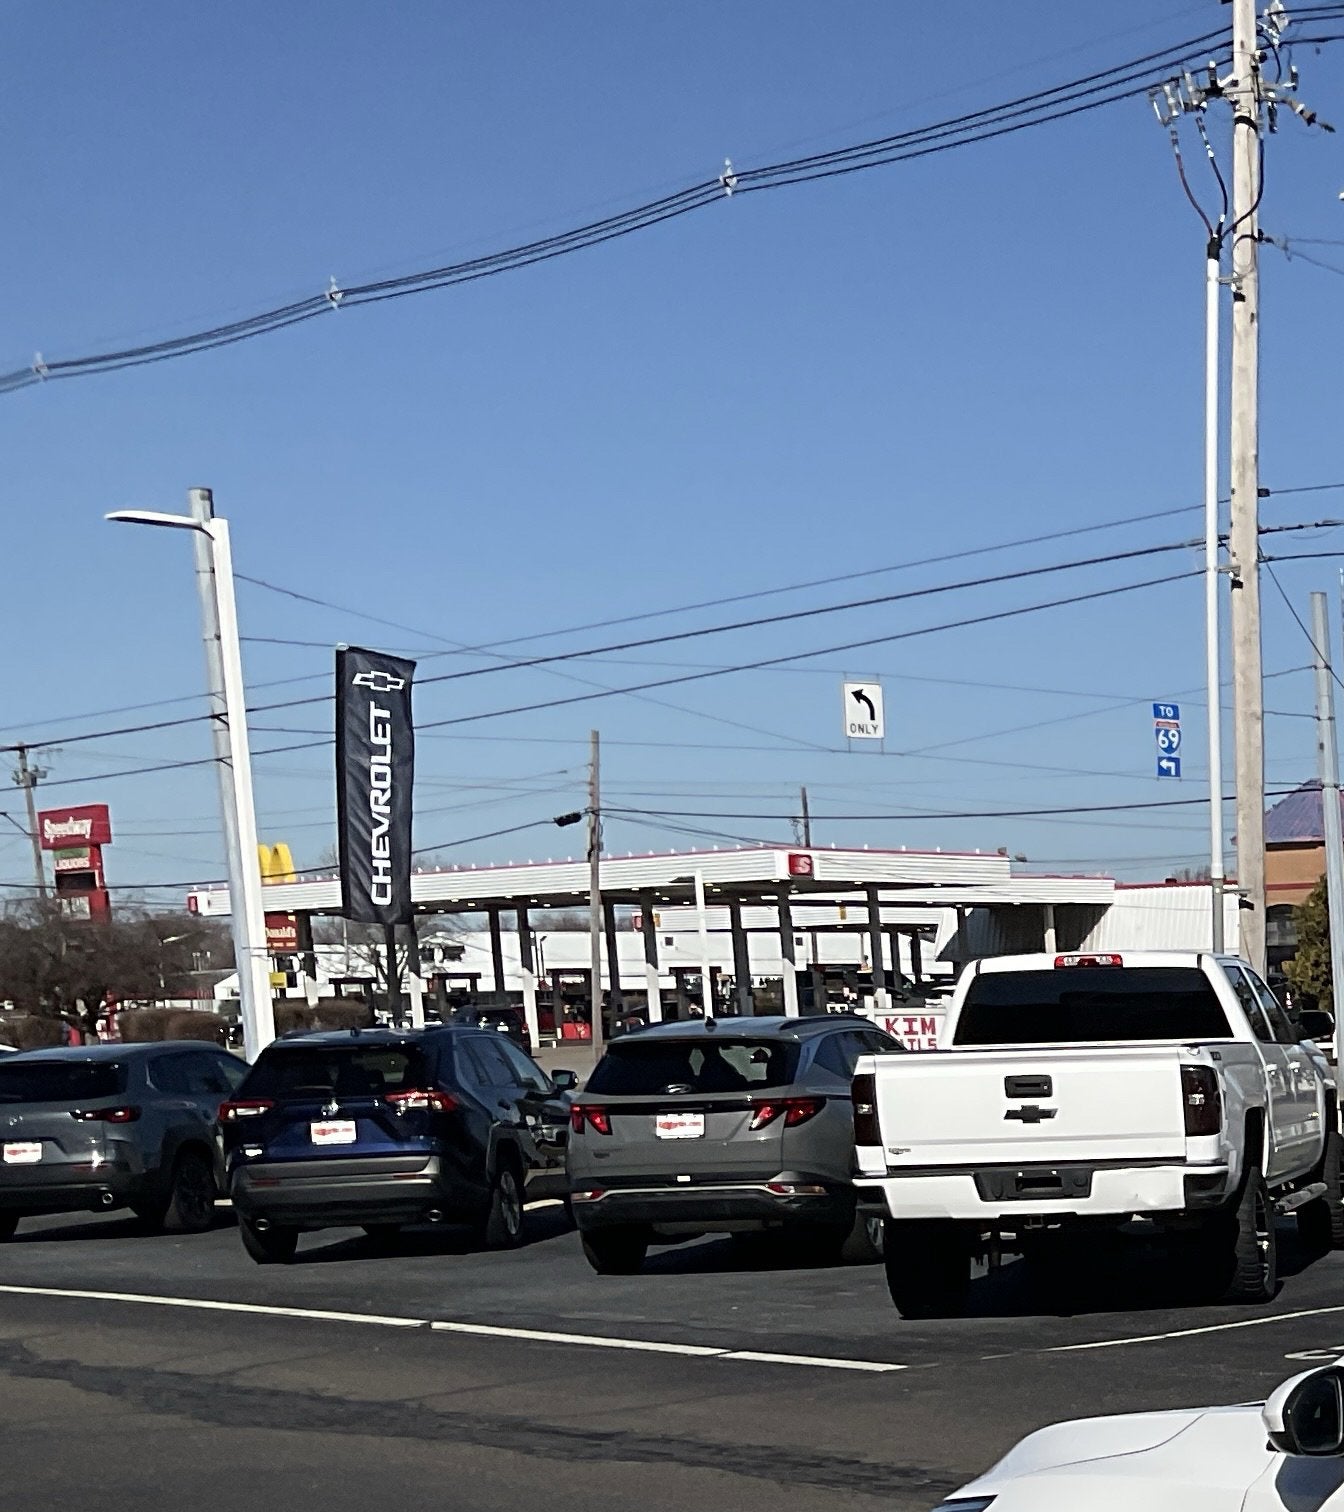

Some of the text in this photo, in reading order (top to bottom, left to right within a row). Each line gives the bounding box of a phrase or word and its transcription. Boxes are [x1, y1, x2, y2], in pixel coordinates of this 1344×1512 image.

[1159, 705, 1174, 717] TO
[850, 723, 879, 735] ONLY
[1158, 729, 1179, 749] 69
[369, 701, 392, 906] CHEVROLET
[885, 1017, 937, 1036] KIM
